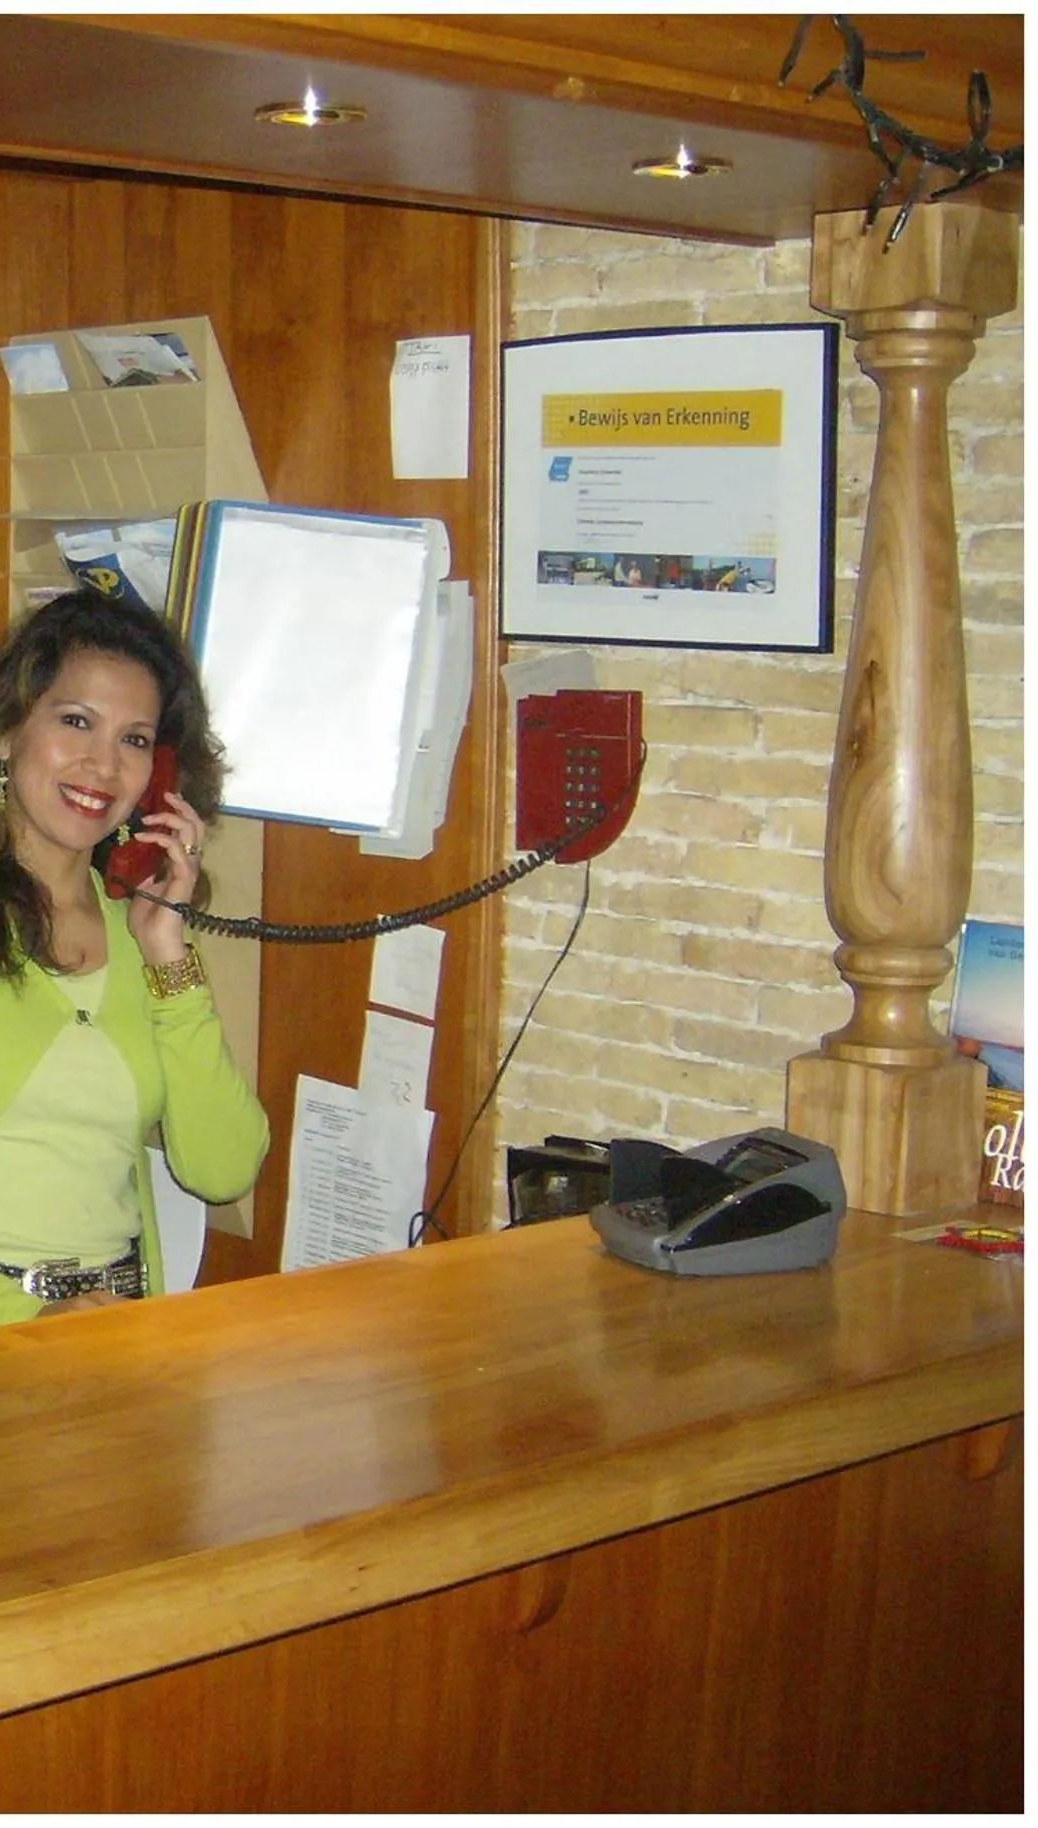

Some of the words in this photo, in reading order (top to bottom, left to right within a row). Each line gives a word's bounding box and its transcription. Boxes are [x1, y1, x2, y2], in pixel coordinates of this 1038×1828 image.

[578, 409, 628, 431] Bewijs
[634, 412, 661, 425] van
[666, 407, 750, 430] Erkenning
